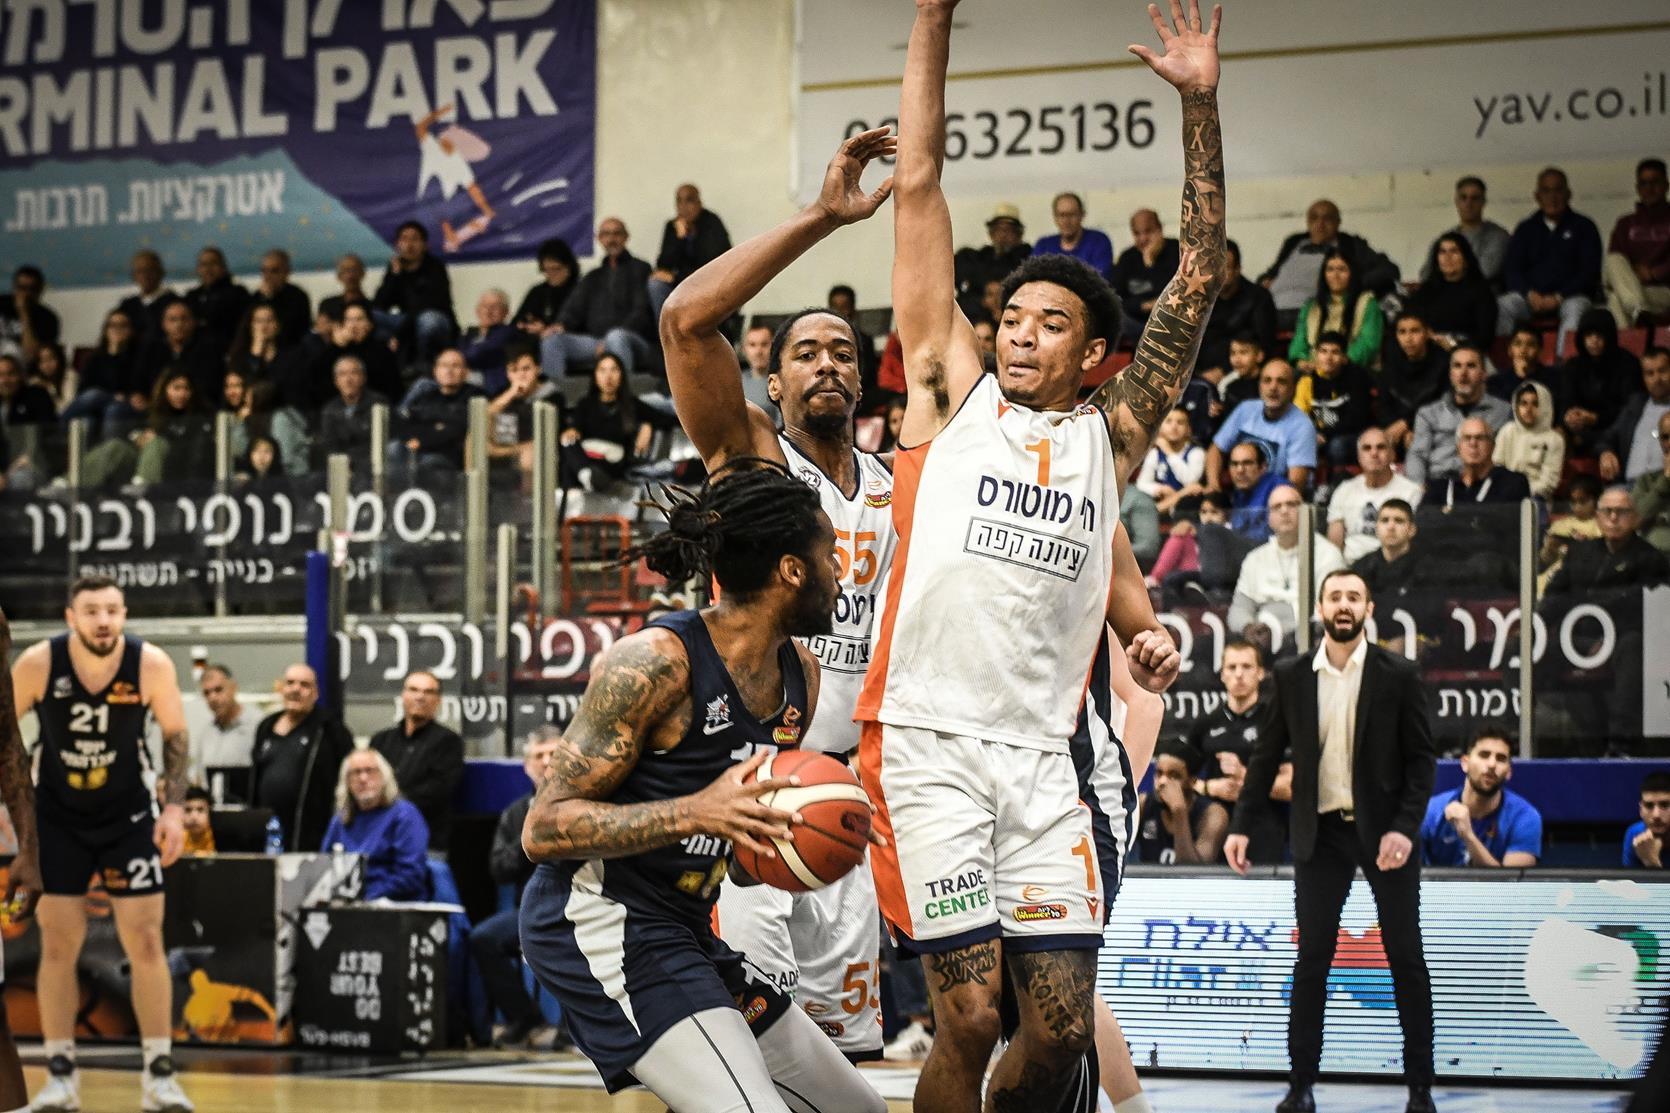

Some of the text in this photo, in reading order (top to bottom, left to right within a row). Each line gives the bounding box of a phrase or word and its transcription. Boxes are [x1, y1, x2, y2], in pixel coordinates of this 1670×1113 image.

[312, 29, 559, 132] PARK
[1474, 72, 1666, 138] yav.co.il
[1025, 438, 1051, 487] 1
[177, 493, 293, 546] נופי
[977, 475, 1073, 524] מוטורס
[977, 525, 1081, 572] ציונה קפה
[1452, 604, 1616, 671] סמי
[68, 702, 109, 733] 21
[127, 856, 164, 890] 21
[925, 869, 987, 898] TRADE
[1071, 834, 1097, 893] 1
[924, 887, 990, 920] CENTE
[1143, 913, 1278, 951] אילת
